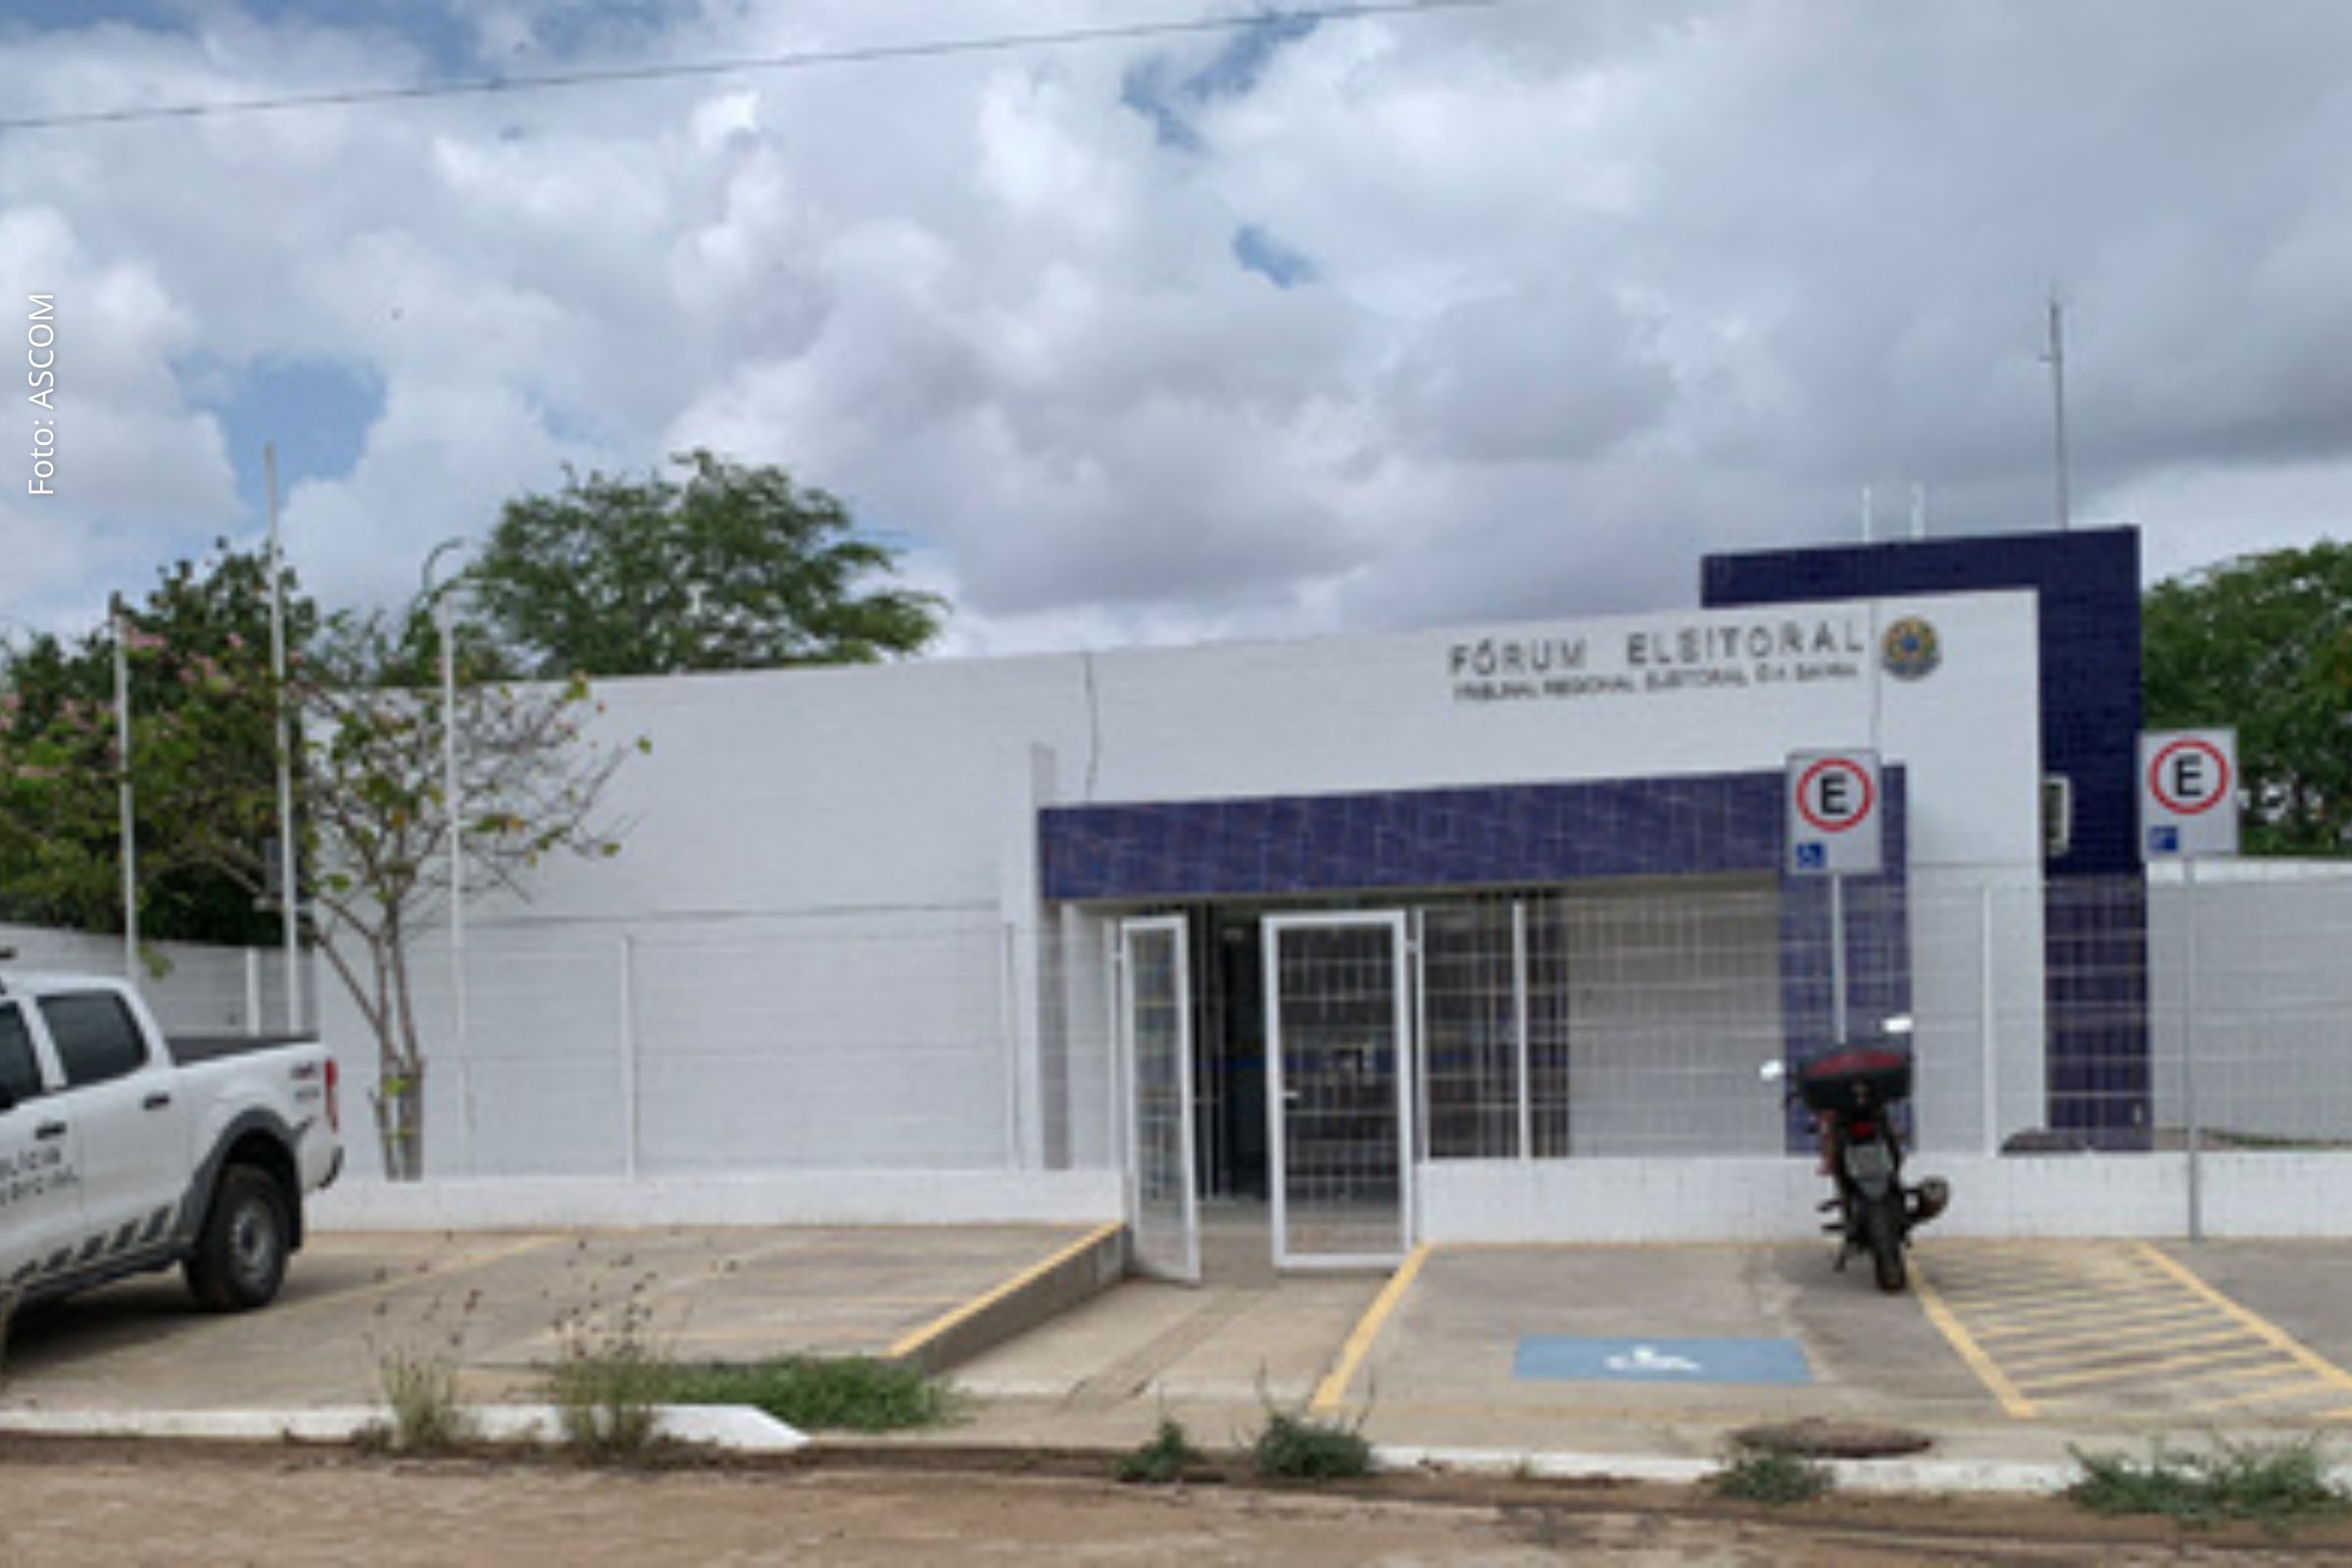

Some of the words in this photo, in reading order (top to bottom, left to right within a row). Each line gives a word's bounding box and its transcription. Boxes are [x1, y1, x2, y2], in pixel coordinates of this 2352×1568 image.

[1448, 638, 1586, 675] FÓRUM
[1626, 621, 1864, 664] ELEITORAL
[1818, 772, 1850, 815] E
[2173, 755, 2203, 798] E
